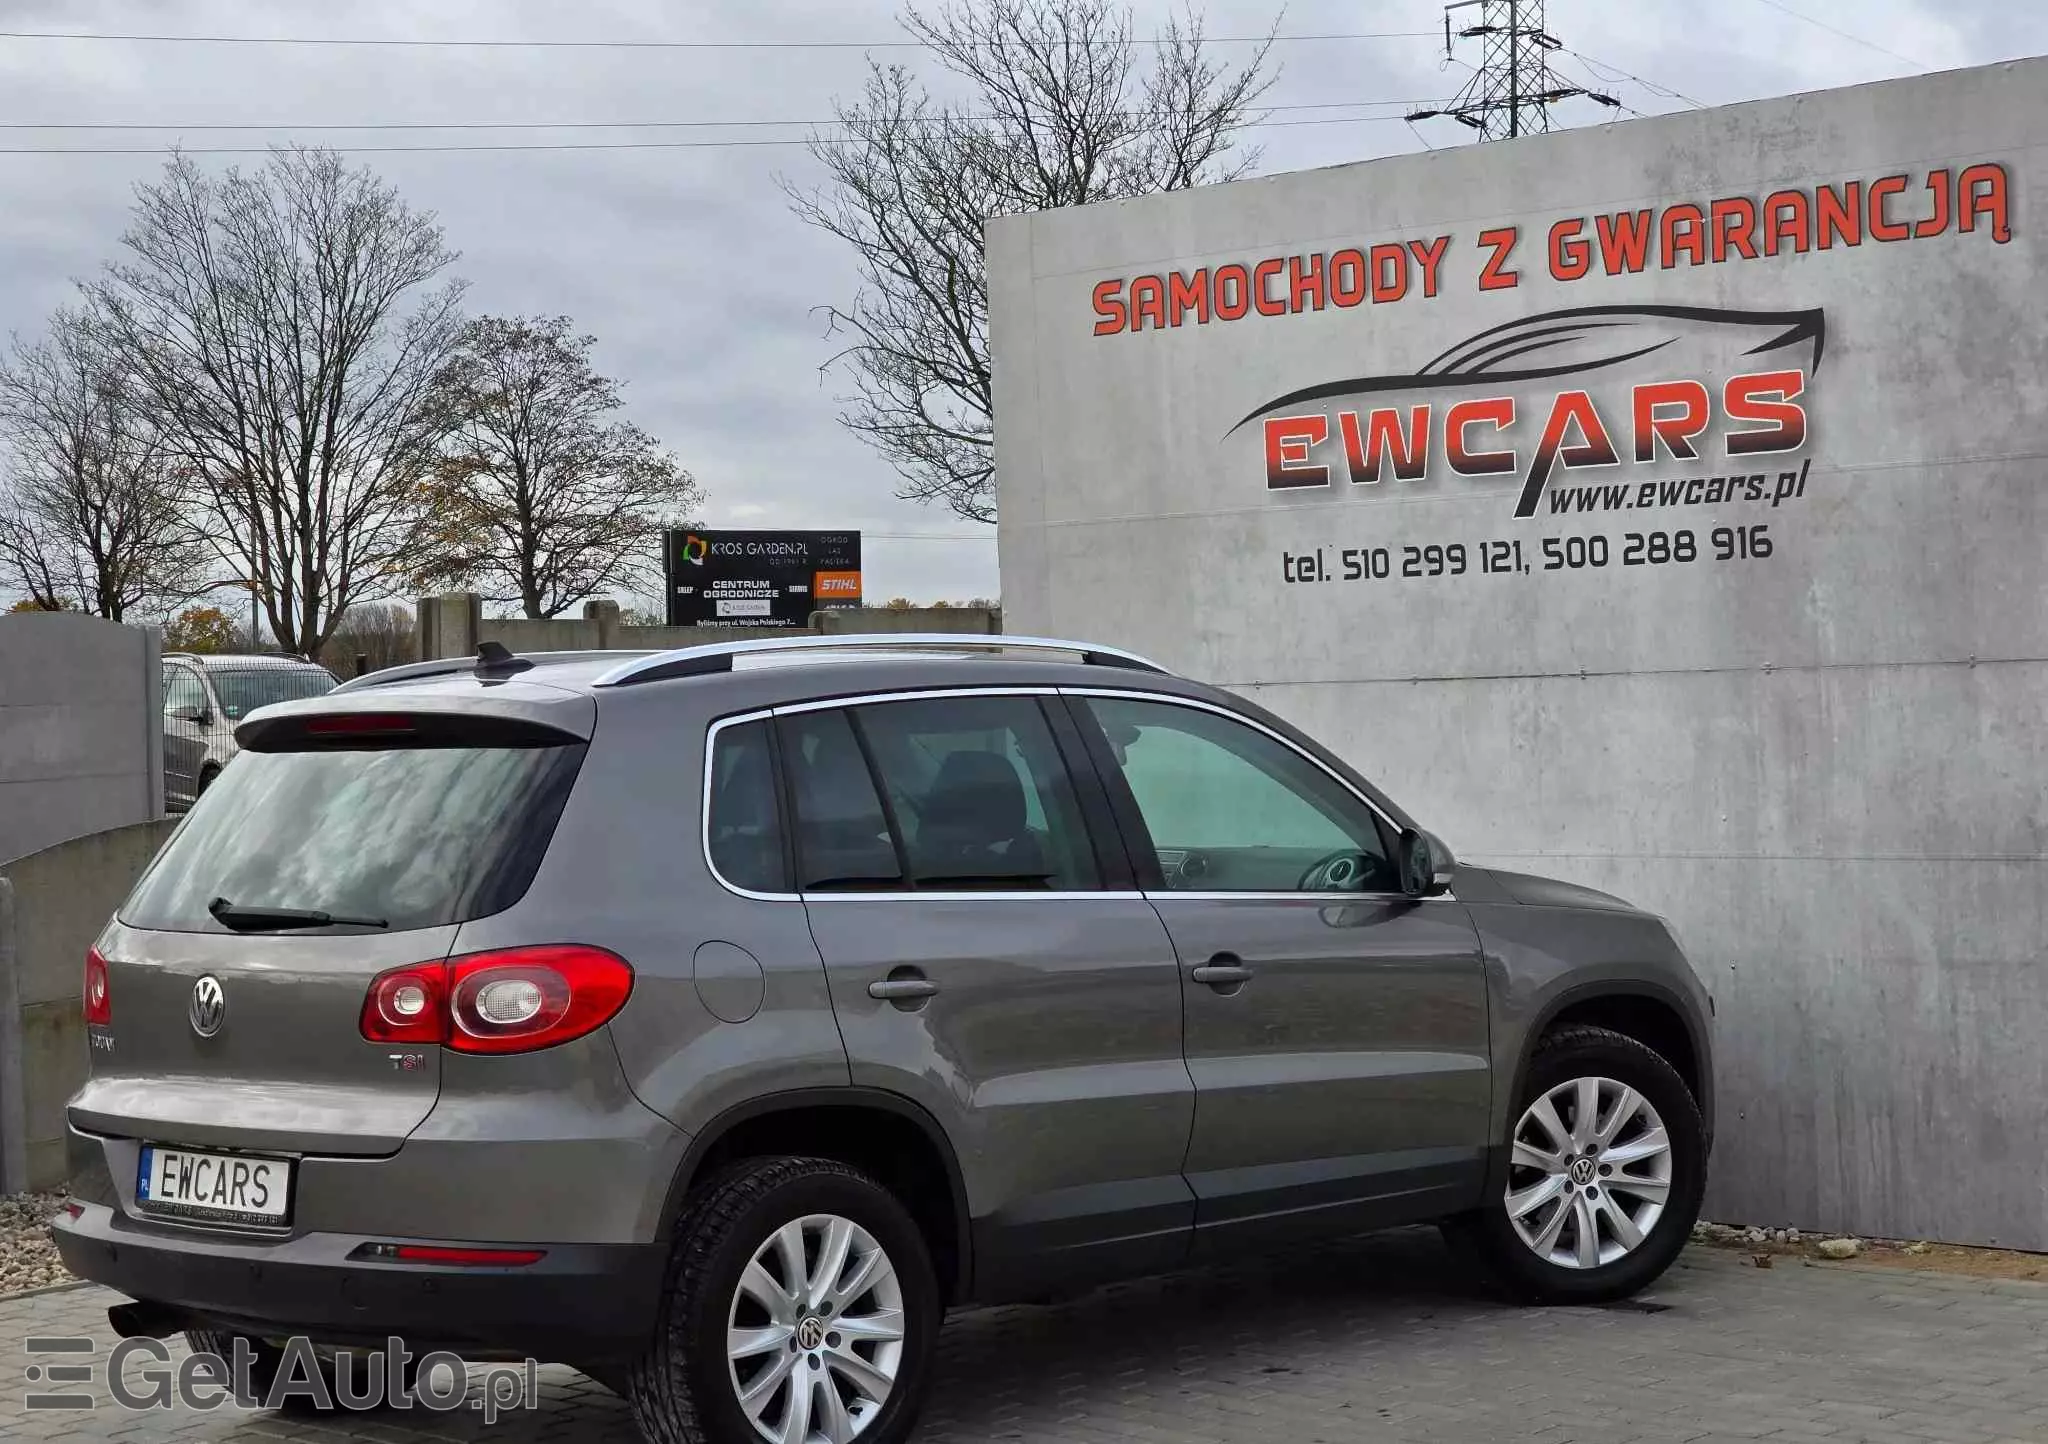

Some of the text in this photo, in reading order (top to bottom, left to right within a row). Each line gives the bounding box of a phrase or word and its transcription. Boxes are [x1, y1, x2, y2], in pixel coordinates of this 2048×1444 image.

[1093, 162, 2012, 338] SAMOCHODY Z GWARANCJĄ
[1262, 367, 1808, 520] EWCARS
[1549, 458, 1813, 515] www.ewcars.pl
[711, 543, 742, 556] KROS
[1283, 524, 1774, 584] tel. 510 299 121, 500 288 916
[703, 589, 780, 599] OGRODNICZE
[712, 580, 770, 589] CENTRUM
[822, 578, 856, 591] STIHL
[160, 1153, 271, 1209] EWCARS
